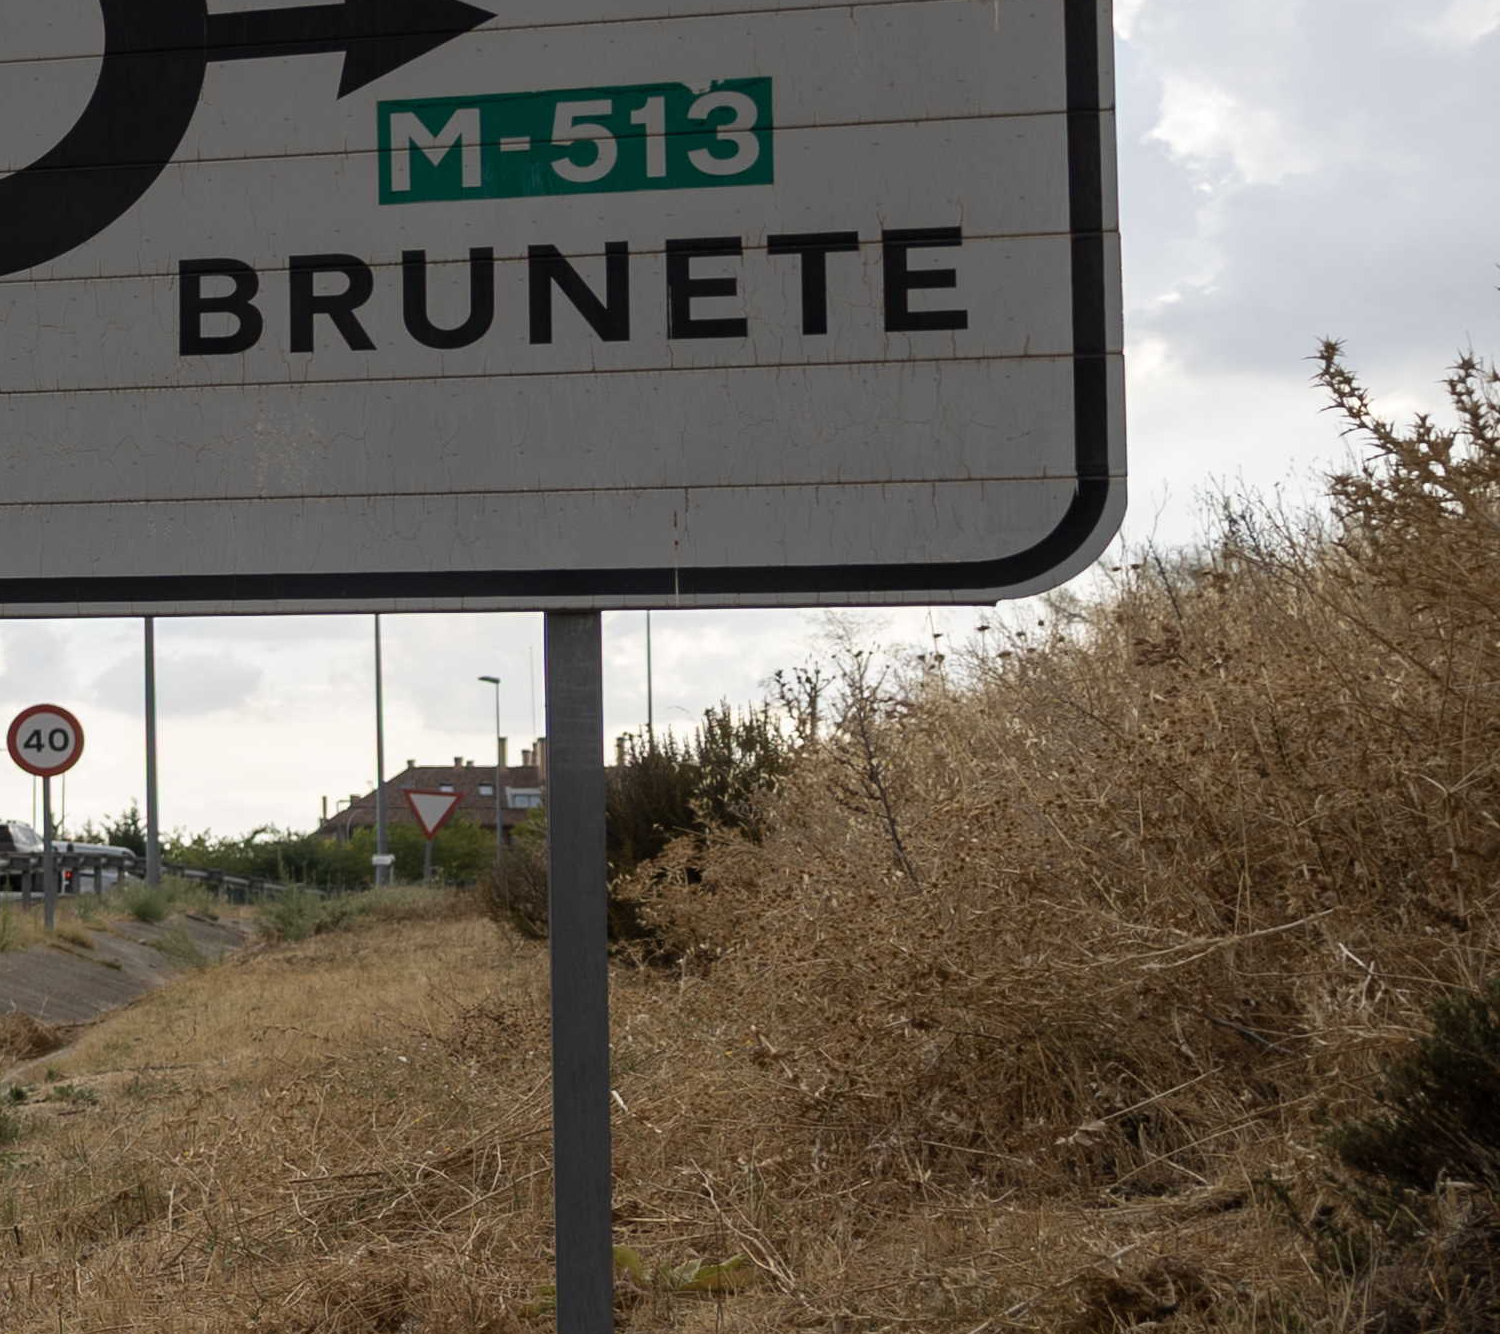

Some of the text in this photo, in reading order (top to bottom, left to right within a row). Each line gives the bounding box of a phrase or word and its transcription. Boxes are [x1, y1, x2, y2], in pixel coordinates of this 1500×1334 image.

[389, 91, 761, 192] M-513
[177, 225, 969, 357] BRUNETE
[23, 728, 69, 752] 40
